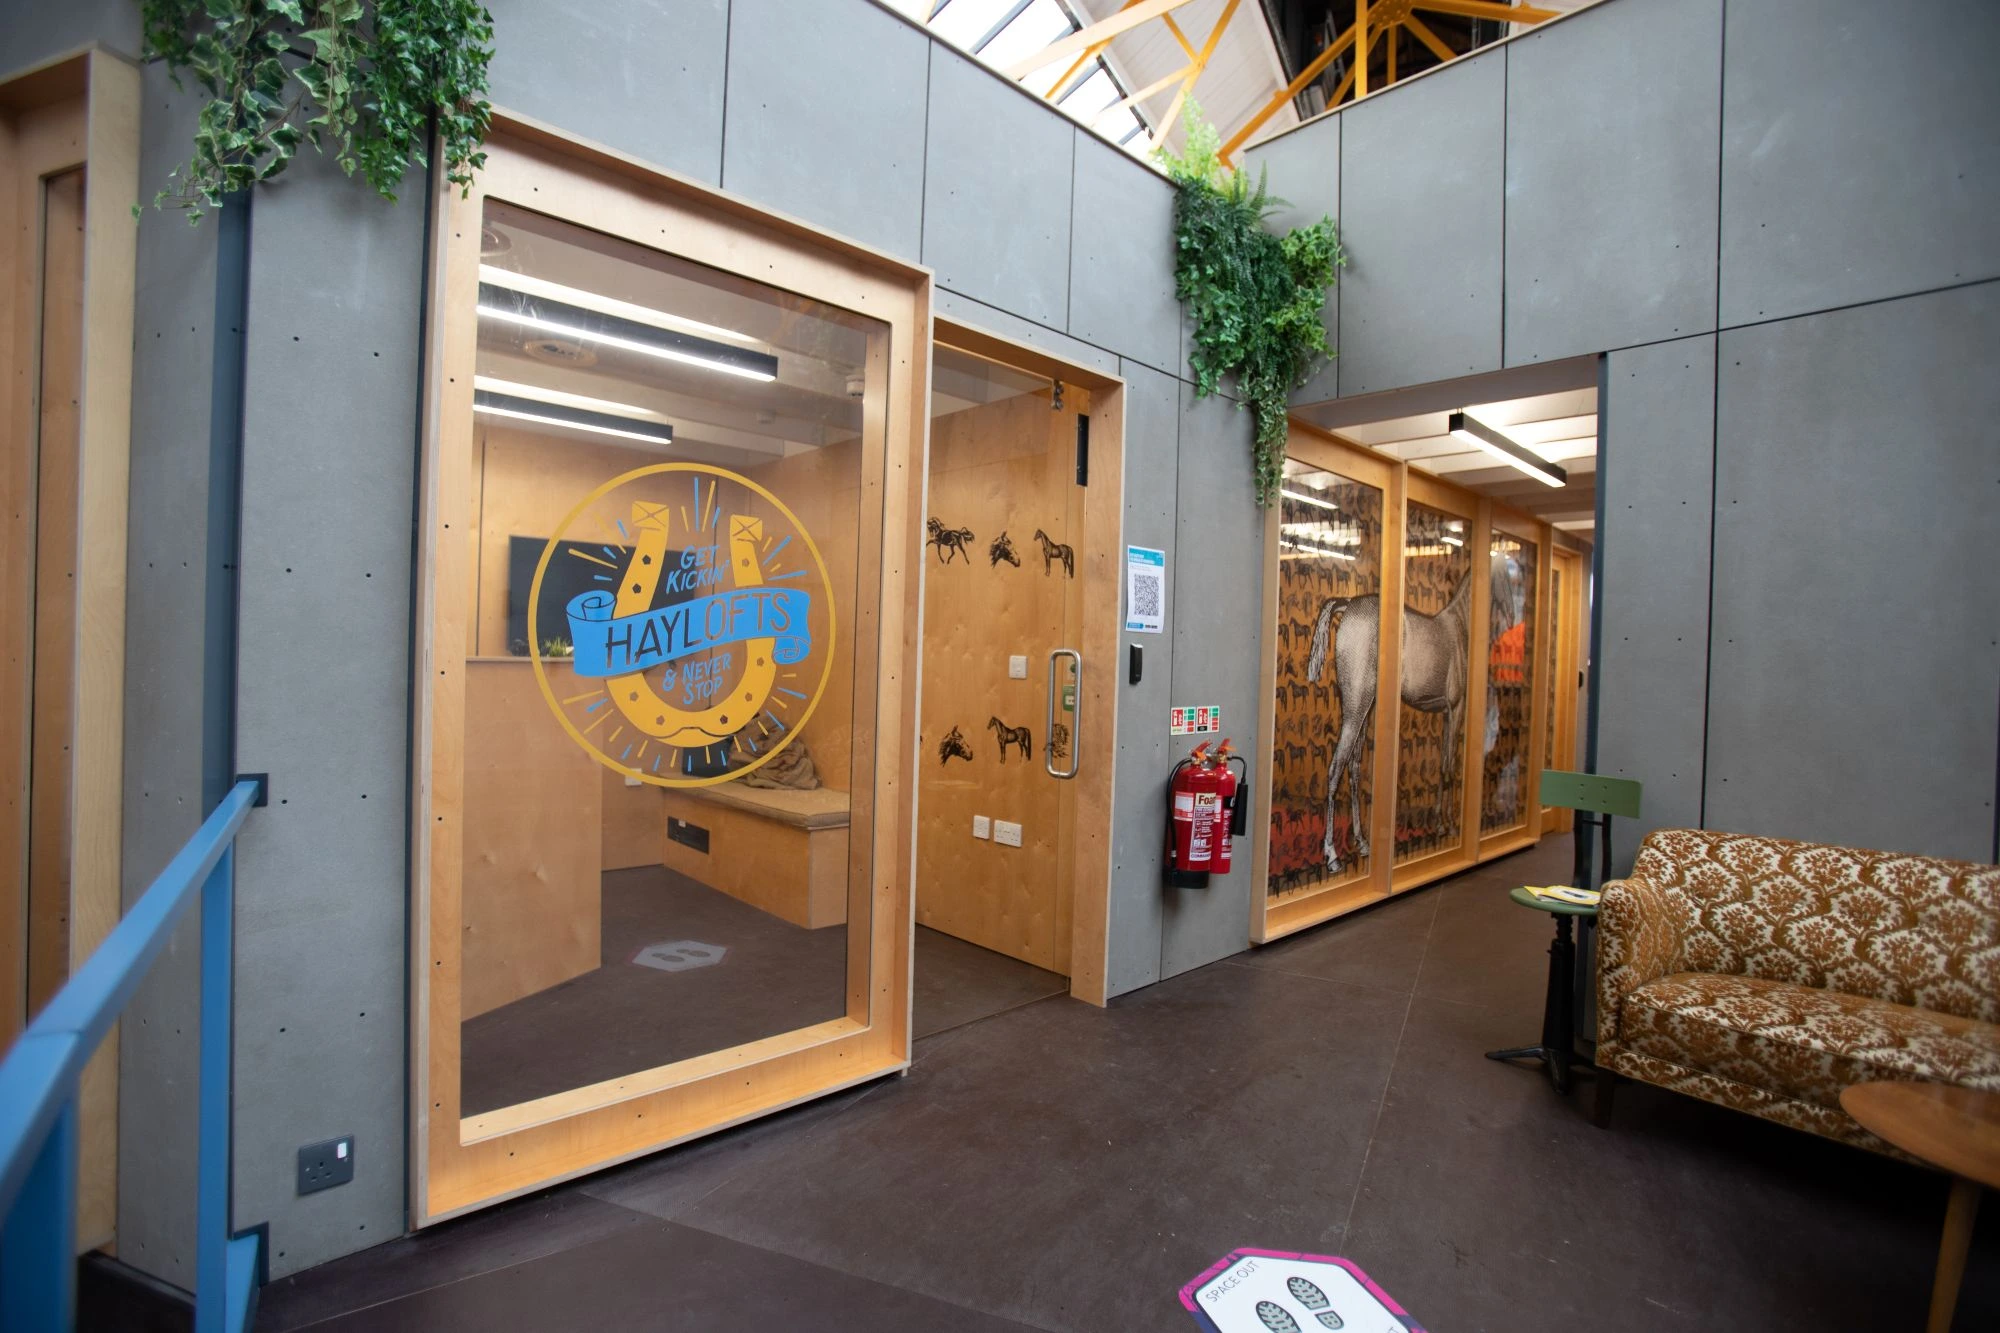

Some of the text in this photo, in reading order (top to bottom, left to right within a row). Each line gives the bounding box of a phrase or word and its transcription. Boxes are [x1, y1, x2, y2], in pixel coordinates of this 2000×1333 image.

[680, 545, 719, 570] GET
[665, 559, 730, 594] KICKIN'
[605, 593, 791, 668] HAYLOFTS
[662, 653, 732, 691] & NEVER
[683, 676, 723, 705] STOP
[1205, 1260, 1260, 1302] SPACE OUT
